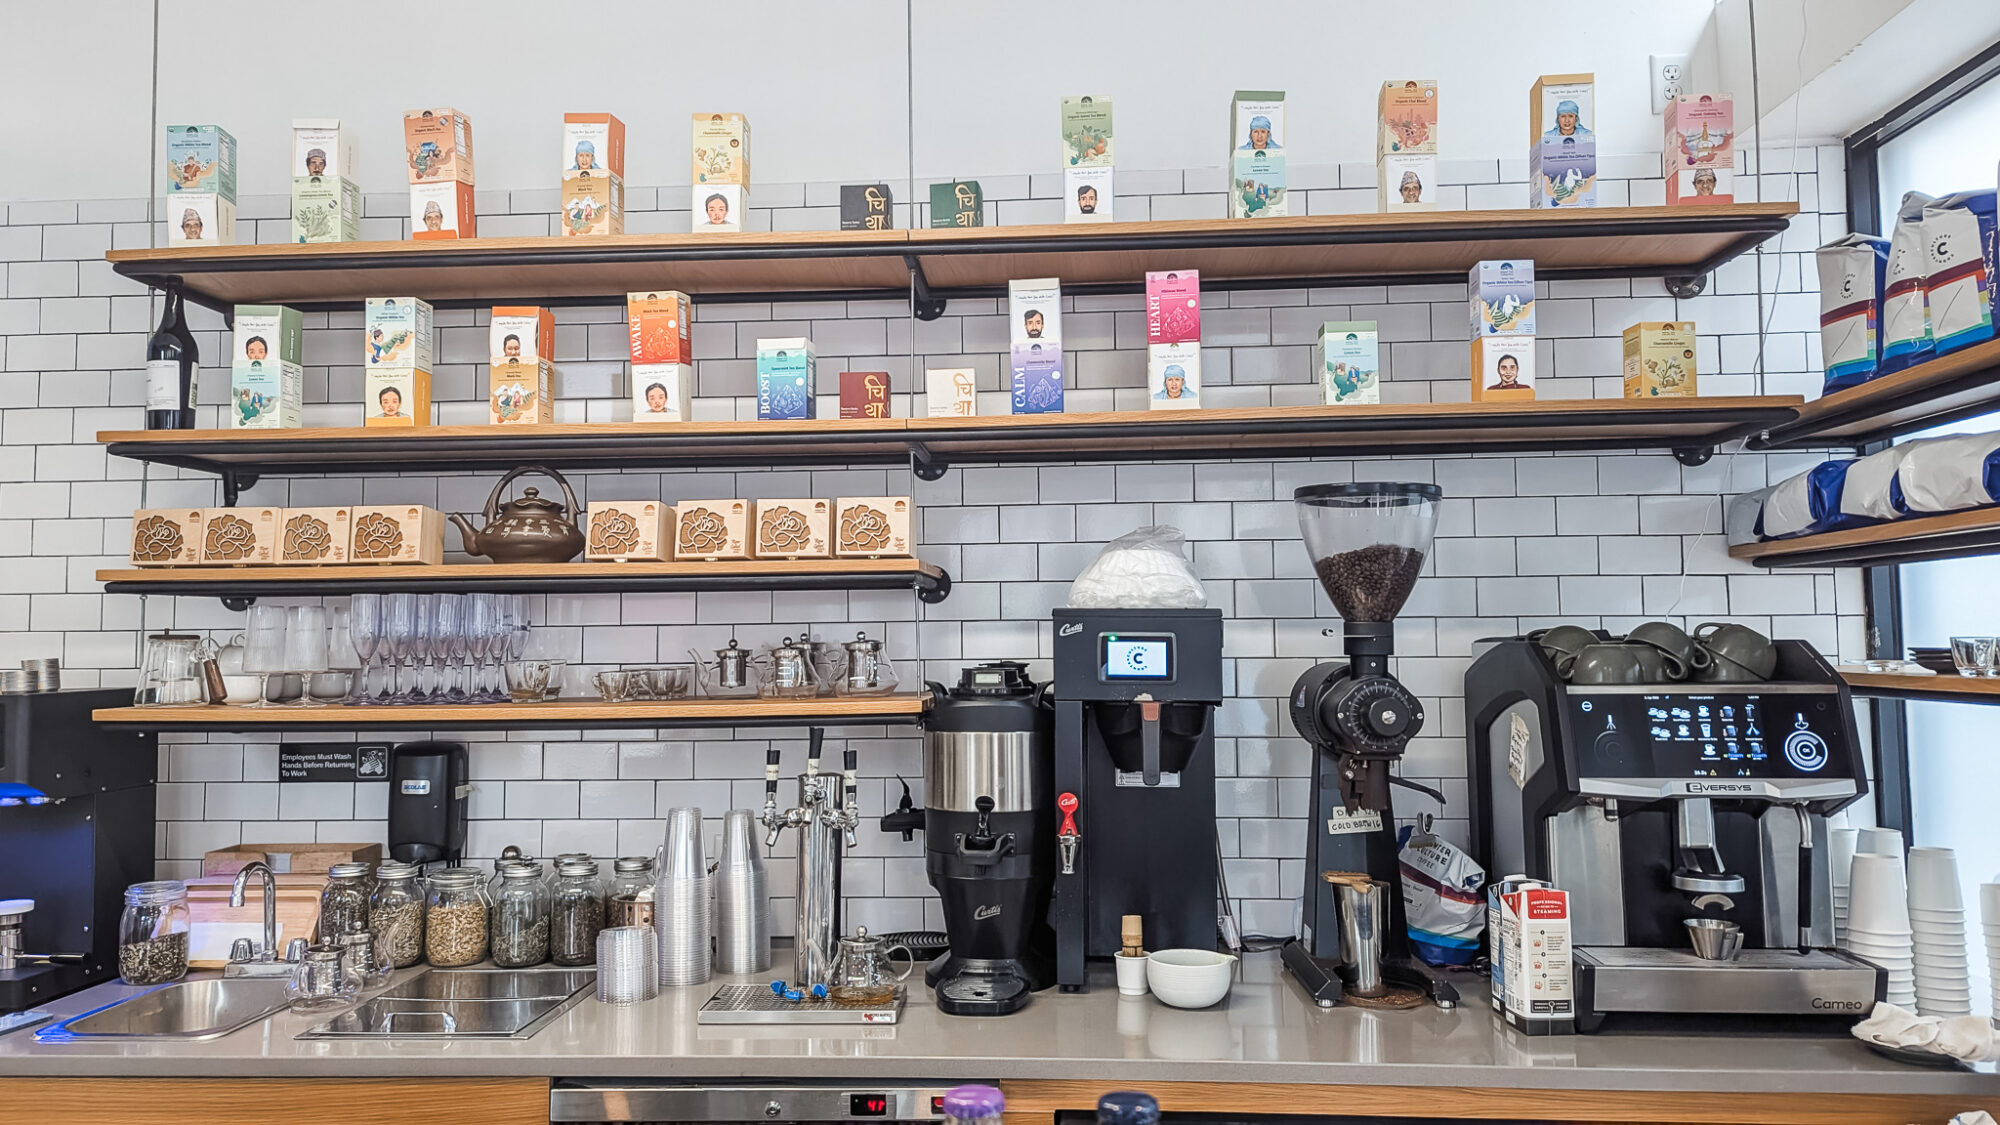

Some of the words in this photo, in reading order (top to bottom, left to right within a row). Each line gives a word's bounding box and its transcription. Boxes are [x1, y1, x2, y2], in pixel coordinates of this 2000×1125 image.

[1150, 294, 1161, 337] HEART
[631, 315, 642, 359] AWAKE
[760, 372, 770, 414] BOOST
[1014, 367, 1026, 408] CALM
[1332, 822, 1351, 831] COLD
[1812, 998, 1862, 1009] Cameo
